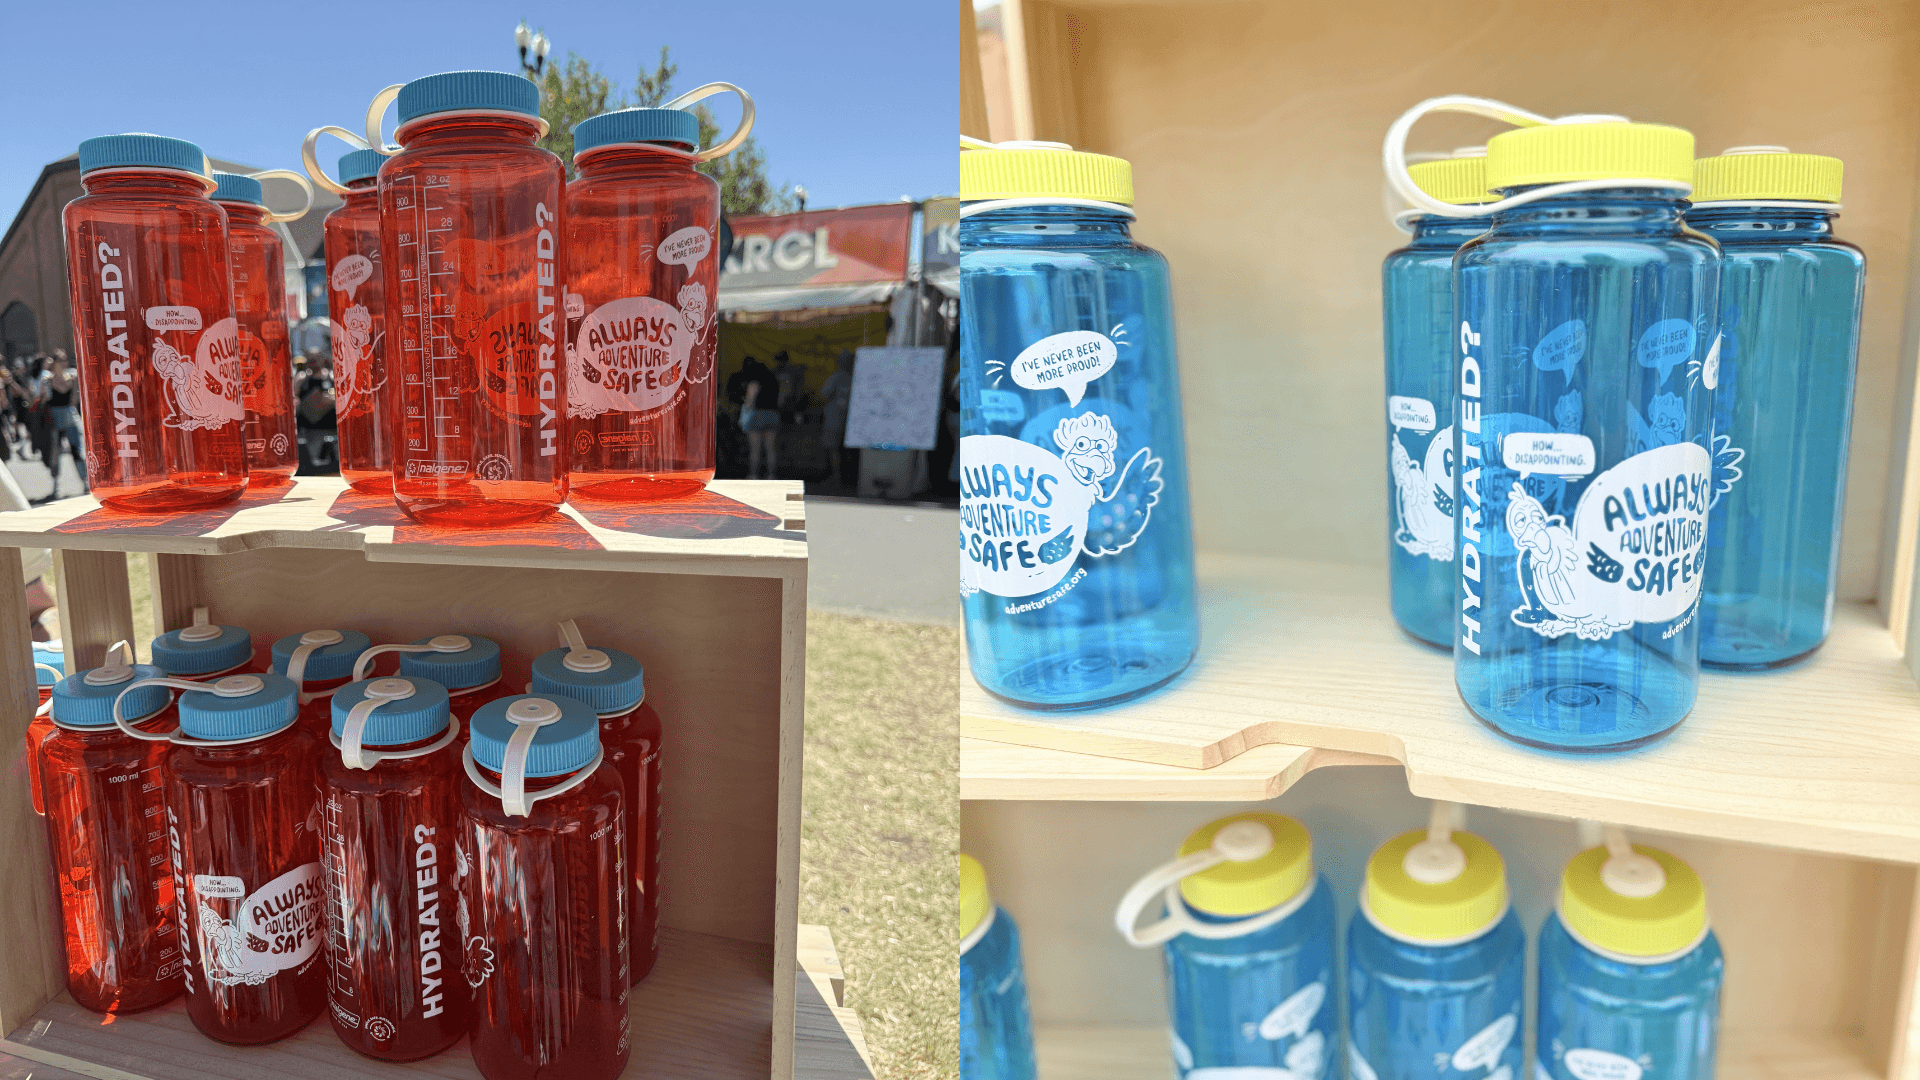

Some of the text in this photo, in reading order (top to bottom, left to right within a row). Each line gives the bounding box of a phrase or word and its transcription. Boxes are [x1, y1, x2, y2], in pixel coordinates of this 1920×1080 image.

[426, 175, 450, 185] 32 oz
[441, 218, 452, 227] 28
[664, 242, 675, 253] I'VE
[677, 238, 693, 249] NEVER
[672, 250, 687, 260] MORE
[443, 261, 454, 270] 24
[444, 304, 456, 313] 20
[535, 202, 557, 457] HYDRATED?
[589, 316, 677, 351] ALWAYS
[99, 242, 139, 458] HYDRATED?
[403, 340, 415, 348] 500
[447, 346, 457, 355] 16
[1022, 341, 1101, 372] I'VE NEVER BEEN
[599, 345, 670, 370] ADVENTURE
[1037, 356, 1101, 383] MORE PROUD!
[405, 373, 417, 382] 400
[603, 369, 657, 394] SAFE
[448, 386, 459, 395] 12
[406, 406, 418, 415] 300
[630, 390, 687, 425] adventuresafe.org
[408, 439, 420, 447] 200
[1532, 440, 1562, 452] HOW...
[420, 463, 462, 476] nalgene
[1515, 453, 1587, 466] DISAPPOINTING.
[960, 463, 1059, 508] LWAYS
[1461, 320, 1481, 656] HYDRATED?
[1603, 473, 1708, 532] ALWAYS
[960, 503, 1051, 537] ADVENTURE
[1620, 517, 1703, 557] ADVENTURE
[969, 533, 1036, 572] SAFE
[1626, 553, 1692, 597] SAFE
[1005, 568, 1088, 615] adventuresafe.org
[108, 772, 139, 784] 1000 ml
[142, 781, 156, 790] 900
[590, 822, 613, 841] 1000 ml
[167, 805, 195, 995] HYDRATED?
[253, 876, 322, 925] ALWAYS
[265, 901, 320, 935] ADVENTURE
[414, 823, 444, 1019] HYDRATED?
[271, 923, 315, 955] SAFE
[160, 947, 173, 957] 200
